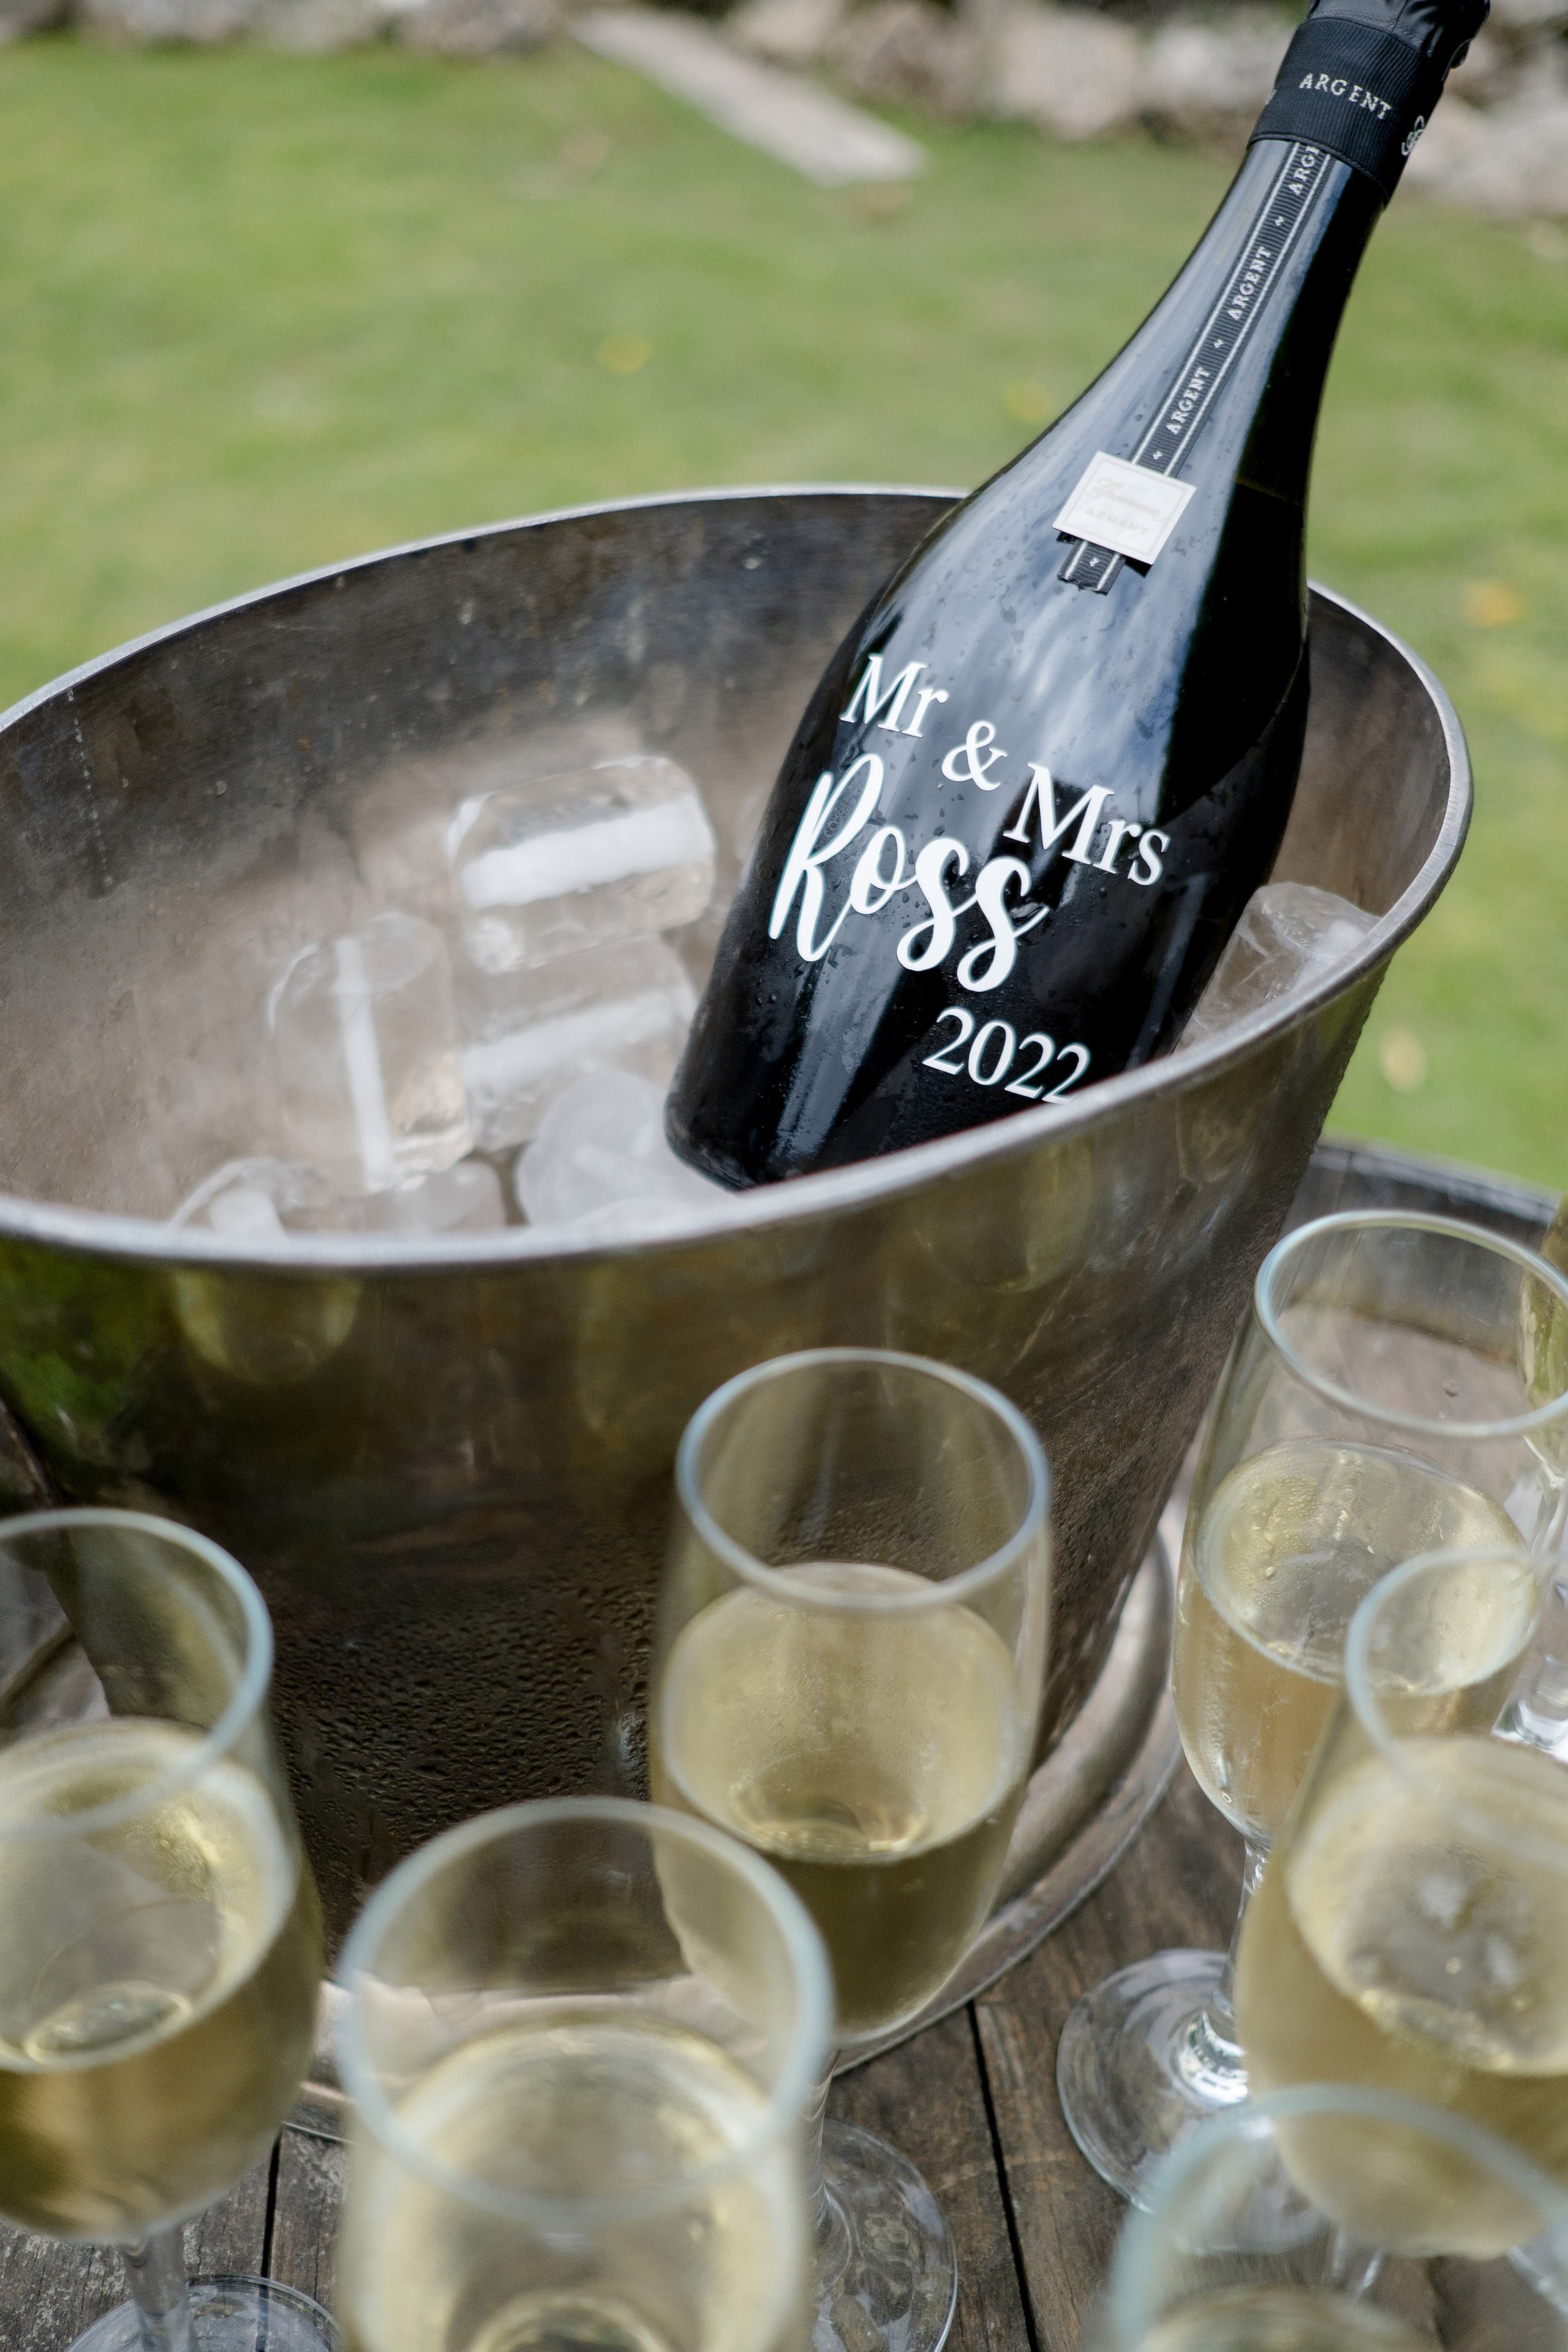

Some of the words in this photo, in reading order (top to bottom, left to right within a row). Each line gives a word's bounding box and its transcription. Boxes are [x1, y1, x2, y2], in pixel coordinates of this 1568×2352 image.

[1298, 73, 1392, 120] ARGENT
[1166, 366, 1211, 435] ARGENT
[1227, 245, 1272, 322] ARGENT
[840, 652, 949, 739] Mr
[941, 720, 1007, 791] &
[1003, 763, 1171, 886] Mrs
[768, 753, 1052, 992] Ross
[922, 1006, 1091, 1104] 2022
